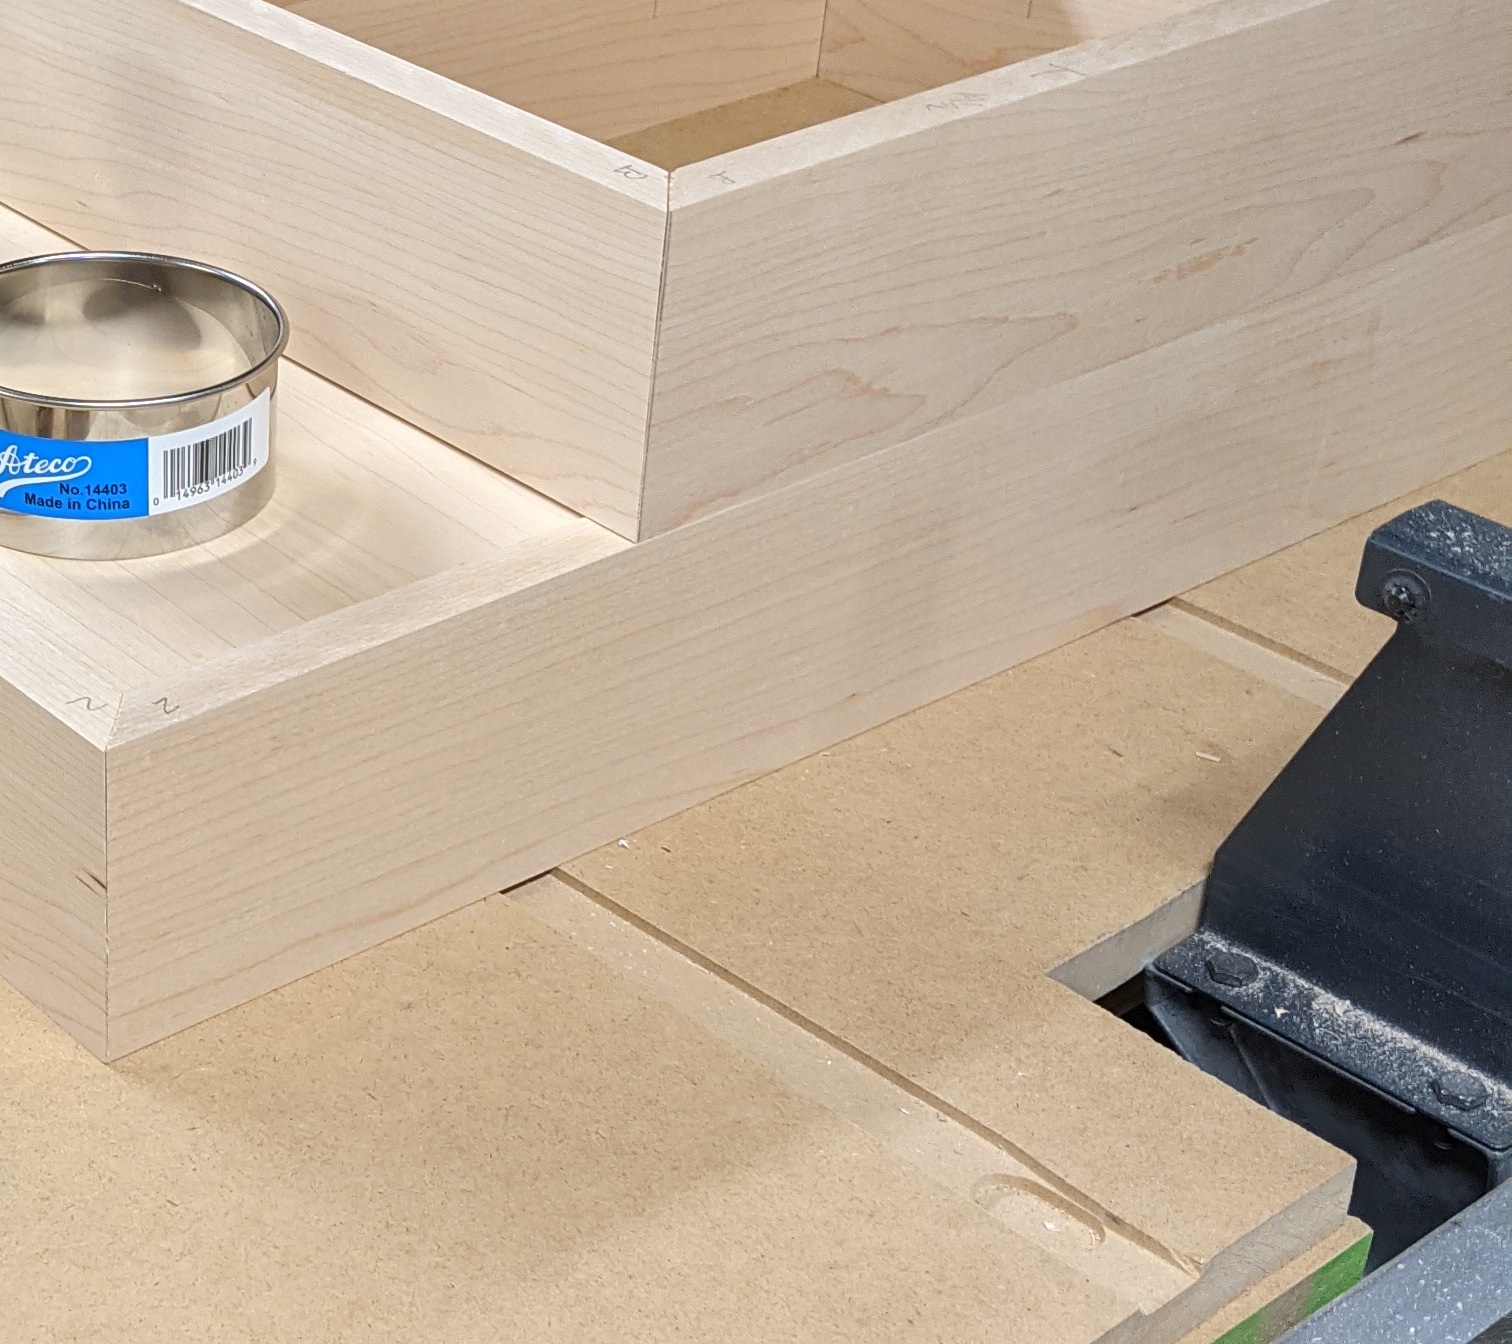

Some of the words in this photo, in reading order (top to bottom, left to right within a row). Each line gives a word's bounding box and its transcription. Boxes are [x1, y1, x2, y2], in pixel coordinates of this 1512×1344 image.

[59, 483, 128, 497] No.14403
[24, 492, 63, 510] Made
[67, 497, 82, 511] in
[85, 498, 131, 511] China
